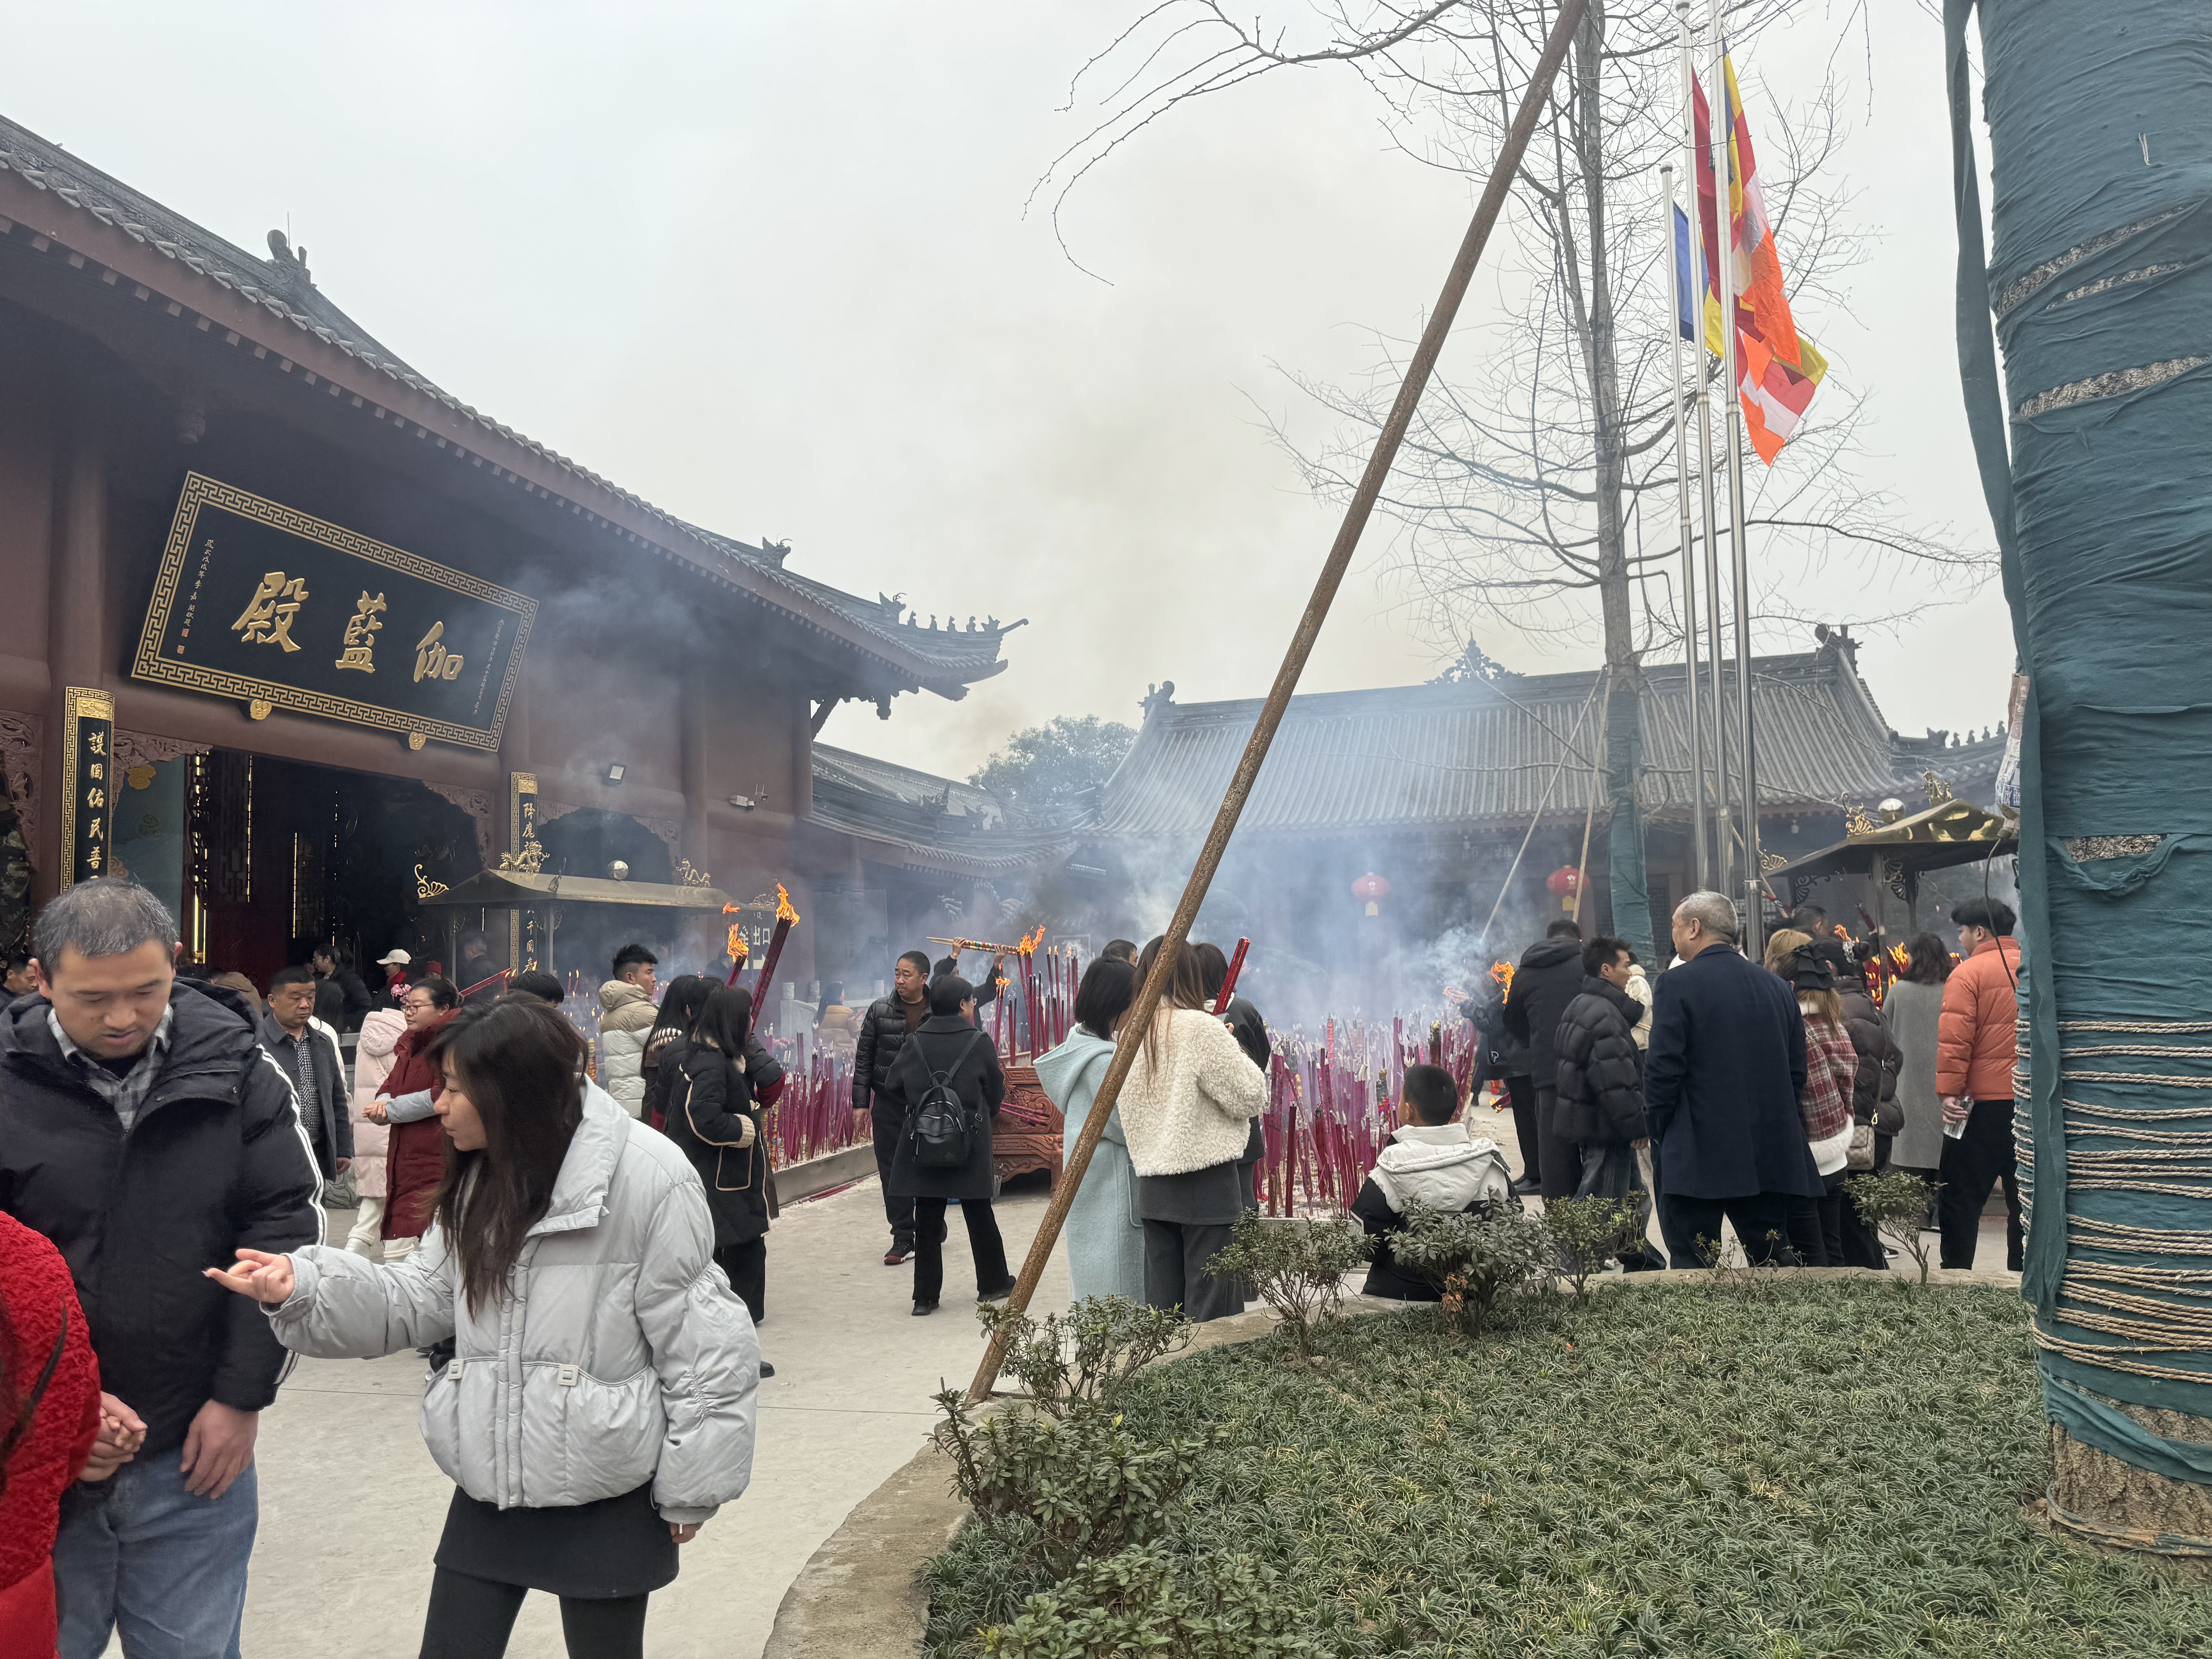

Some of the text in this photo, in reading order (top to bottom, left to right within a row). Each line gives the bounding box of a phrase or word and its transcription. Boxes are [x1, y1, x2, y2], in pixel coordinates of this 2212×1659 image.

[87, 731, 106, 879] 護國佑民普
